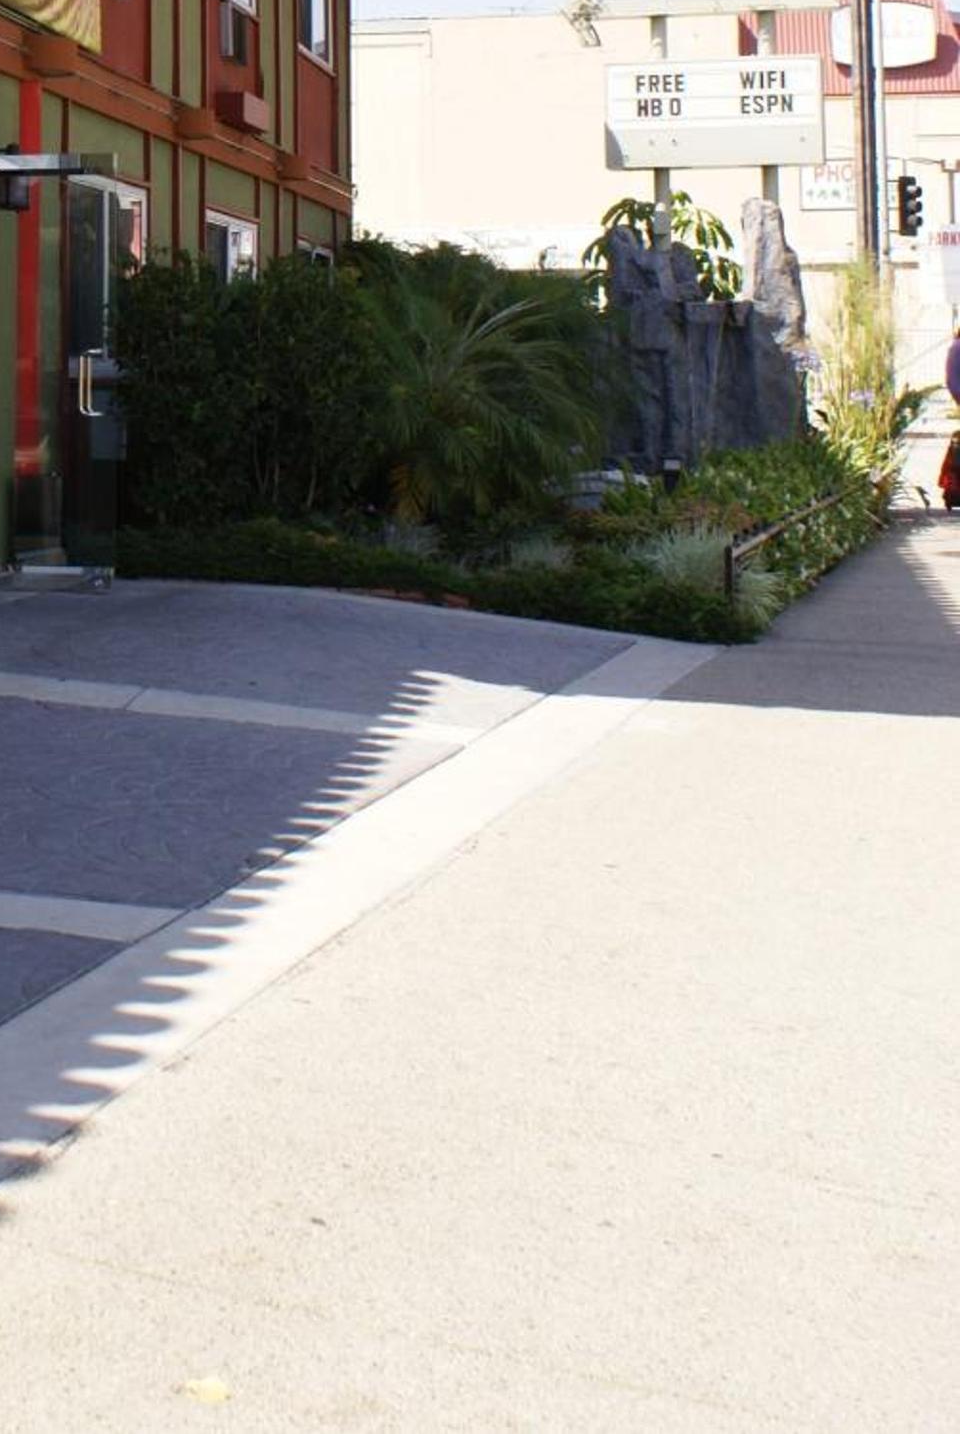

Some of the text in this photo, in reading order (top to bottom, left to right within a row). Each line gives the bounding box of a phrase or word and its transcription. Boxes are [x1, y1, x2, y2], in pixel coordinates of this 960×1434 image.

[635, 70, 786, 93] FREE WIFI
[740, 94, 794, 115] ESPN
